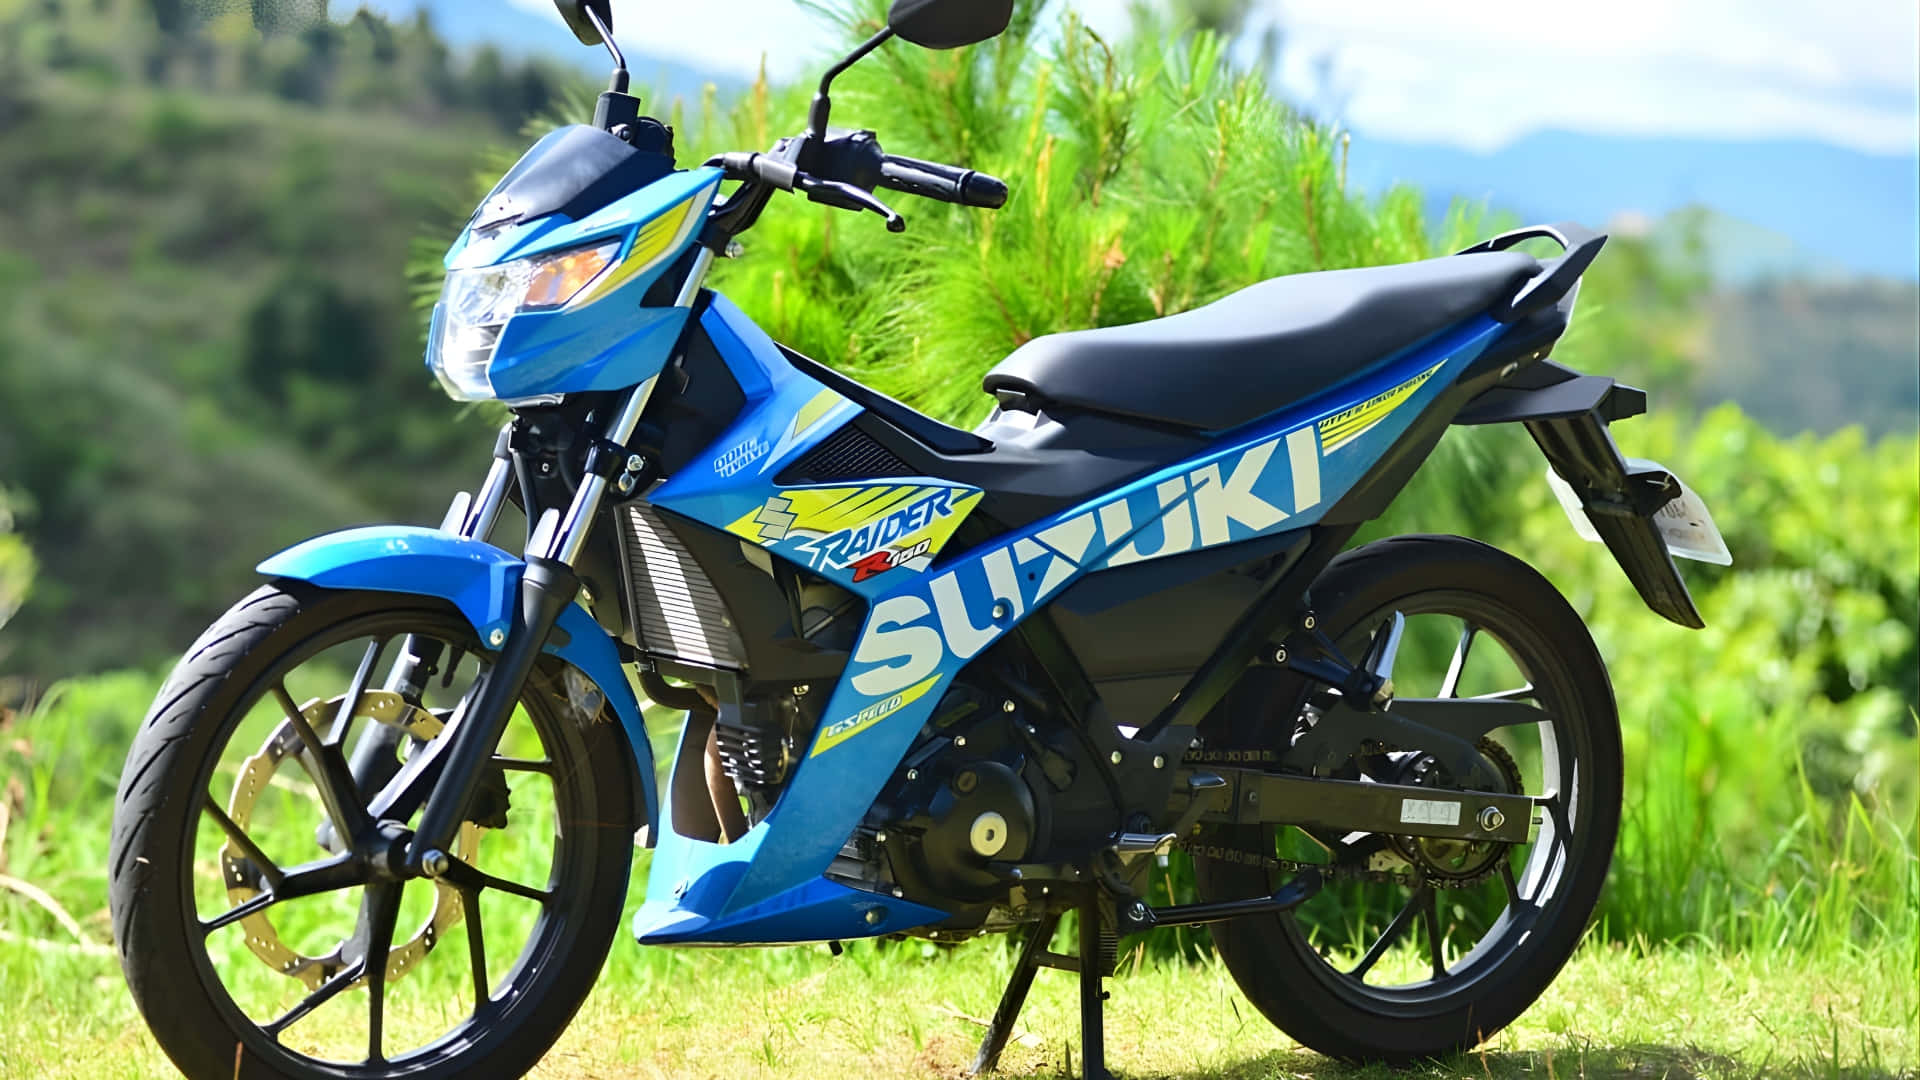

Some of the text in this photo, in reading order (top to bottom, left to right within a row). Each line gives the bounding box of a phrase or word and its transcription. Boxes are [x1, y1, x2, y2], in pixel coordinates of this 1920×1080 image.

[794, 488, 954, 573] RAIDER
[850, 425, 1322, 696] SUZUKI
[852, 537, 932, 584] R150
